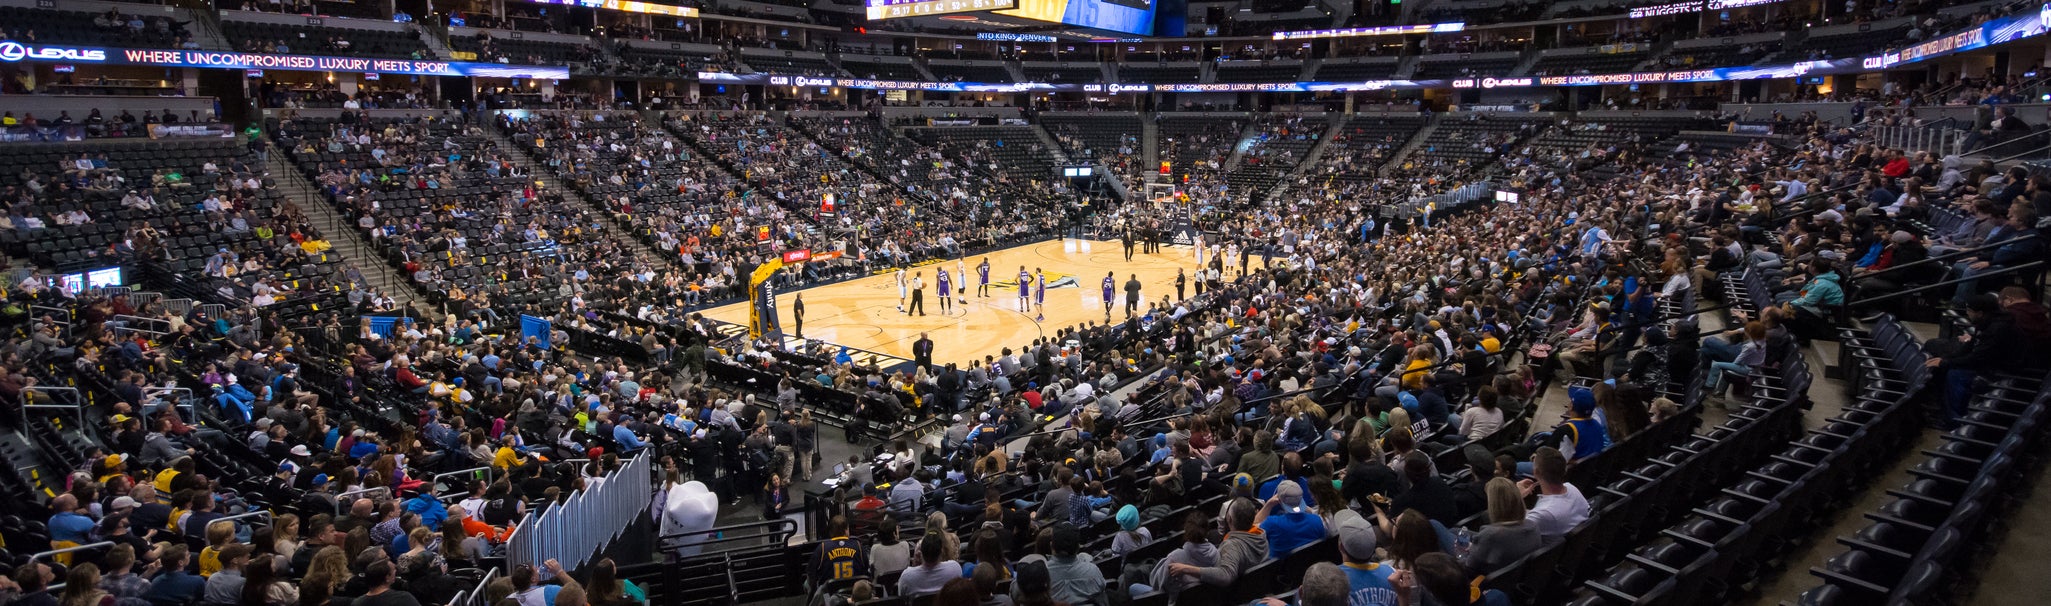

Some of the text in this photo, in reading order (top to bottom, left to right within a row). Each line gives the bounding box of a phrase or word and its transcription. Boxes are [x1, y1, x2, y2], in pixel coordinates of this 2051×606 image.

[27, 47, 105, 60] LEXUS
[125, 50, 449, 72] WHERE UNCOMPROMISED LUXURY MEETS SPORT
[1452, 80, 1473, 88] CLUB
[1569, 74, 1632, 84] UNCOMPROMISED
[1634, 73, 1666, 82] LUXURY
[1668, 72, 1691, 80] MEETS
[1693, 70, 1714, 79] SPORT
[790, 252, 804, 260] xfinity
[765, 280, 774, 308] xfinity
[828, 547, 856, 560] ANTHONY
[833, 561, 853, 579] 15
[1348, 587, 1398, 606] ANTHONY
